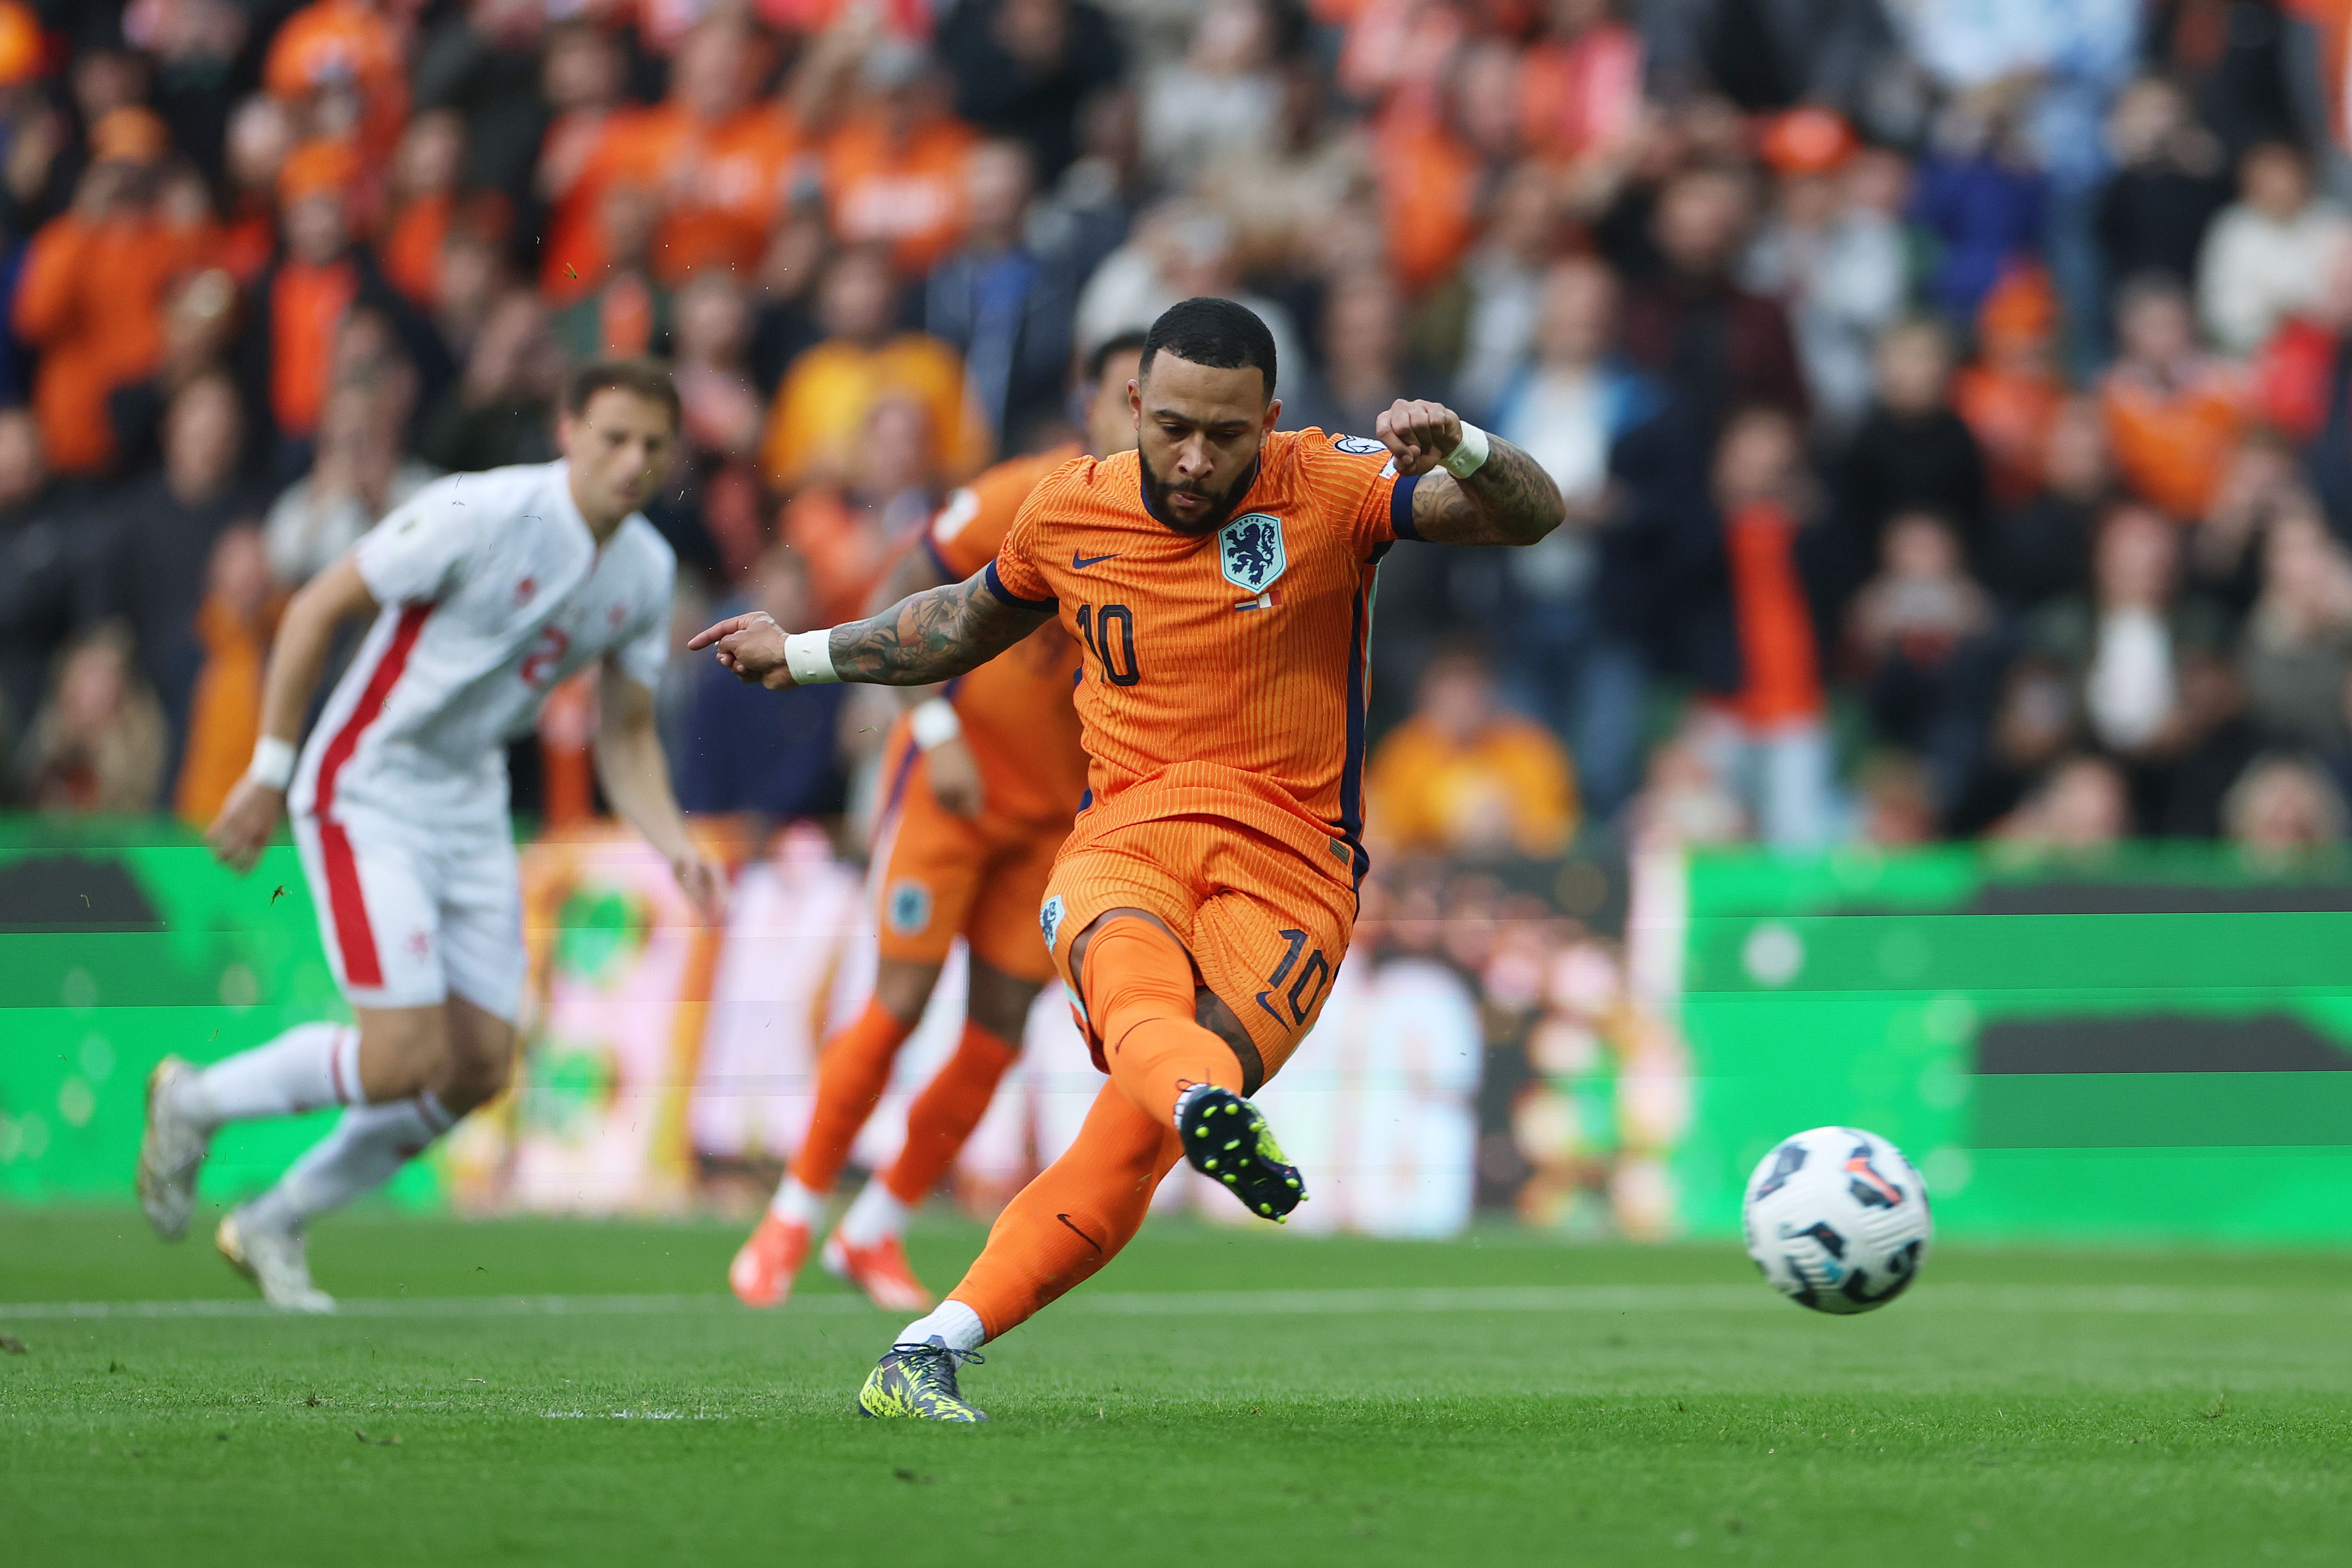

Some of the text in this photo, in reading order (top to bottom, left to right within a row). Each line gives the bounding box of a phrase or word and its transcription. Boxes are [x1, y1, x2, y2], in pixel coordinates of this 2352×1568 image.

[521, 624, 570, 688] 2
[1076, 604, 1140, 686] 10
[1268, 928, 1329, 1026] 10
